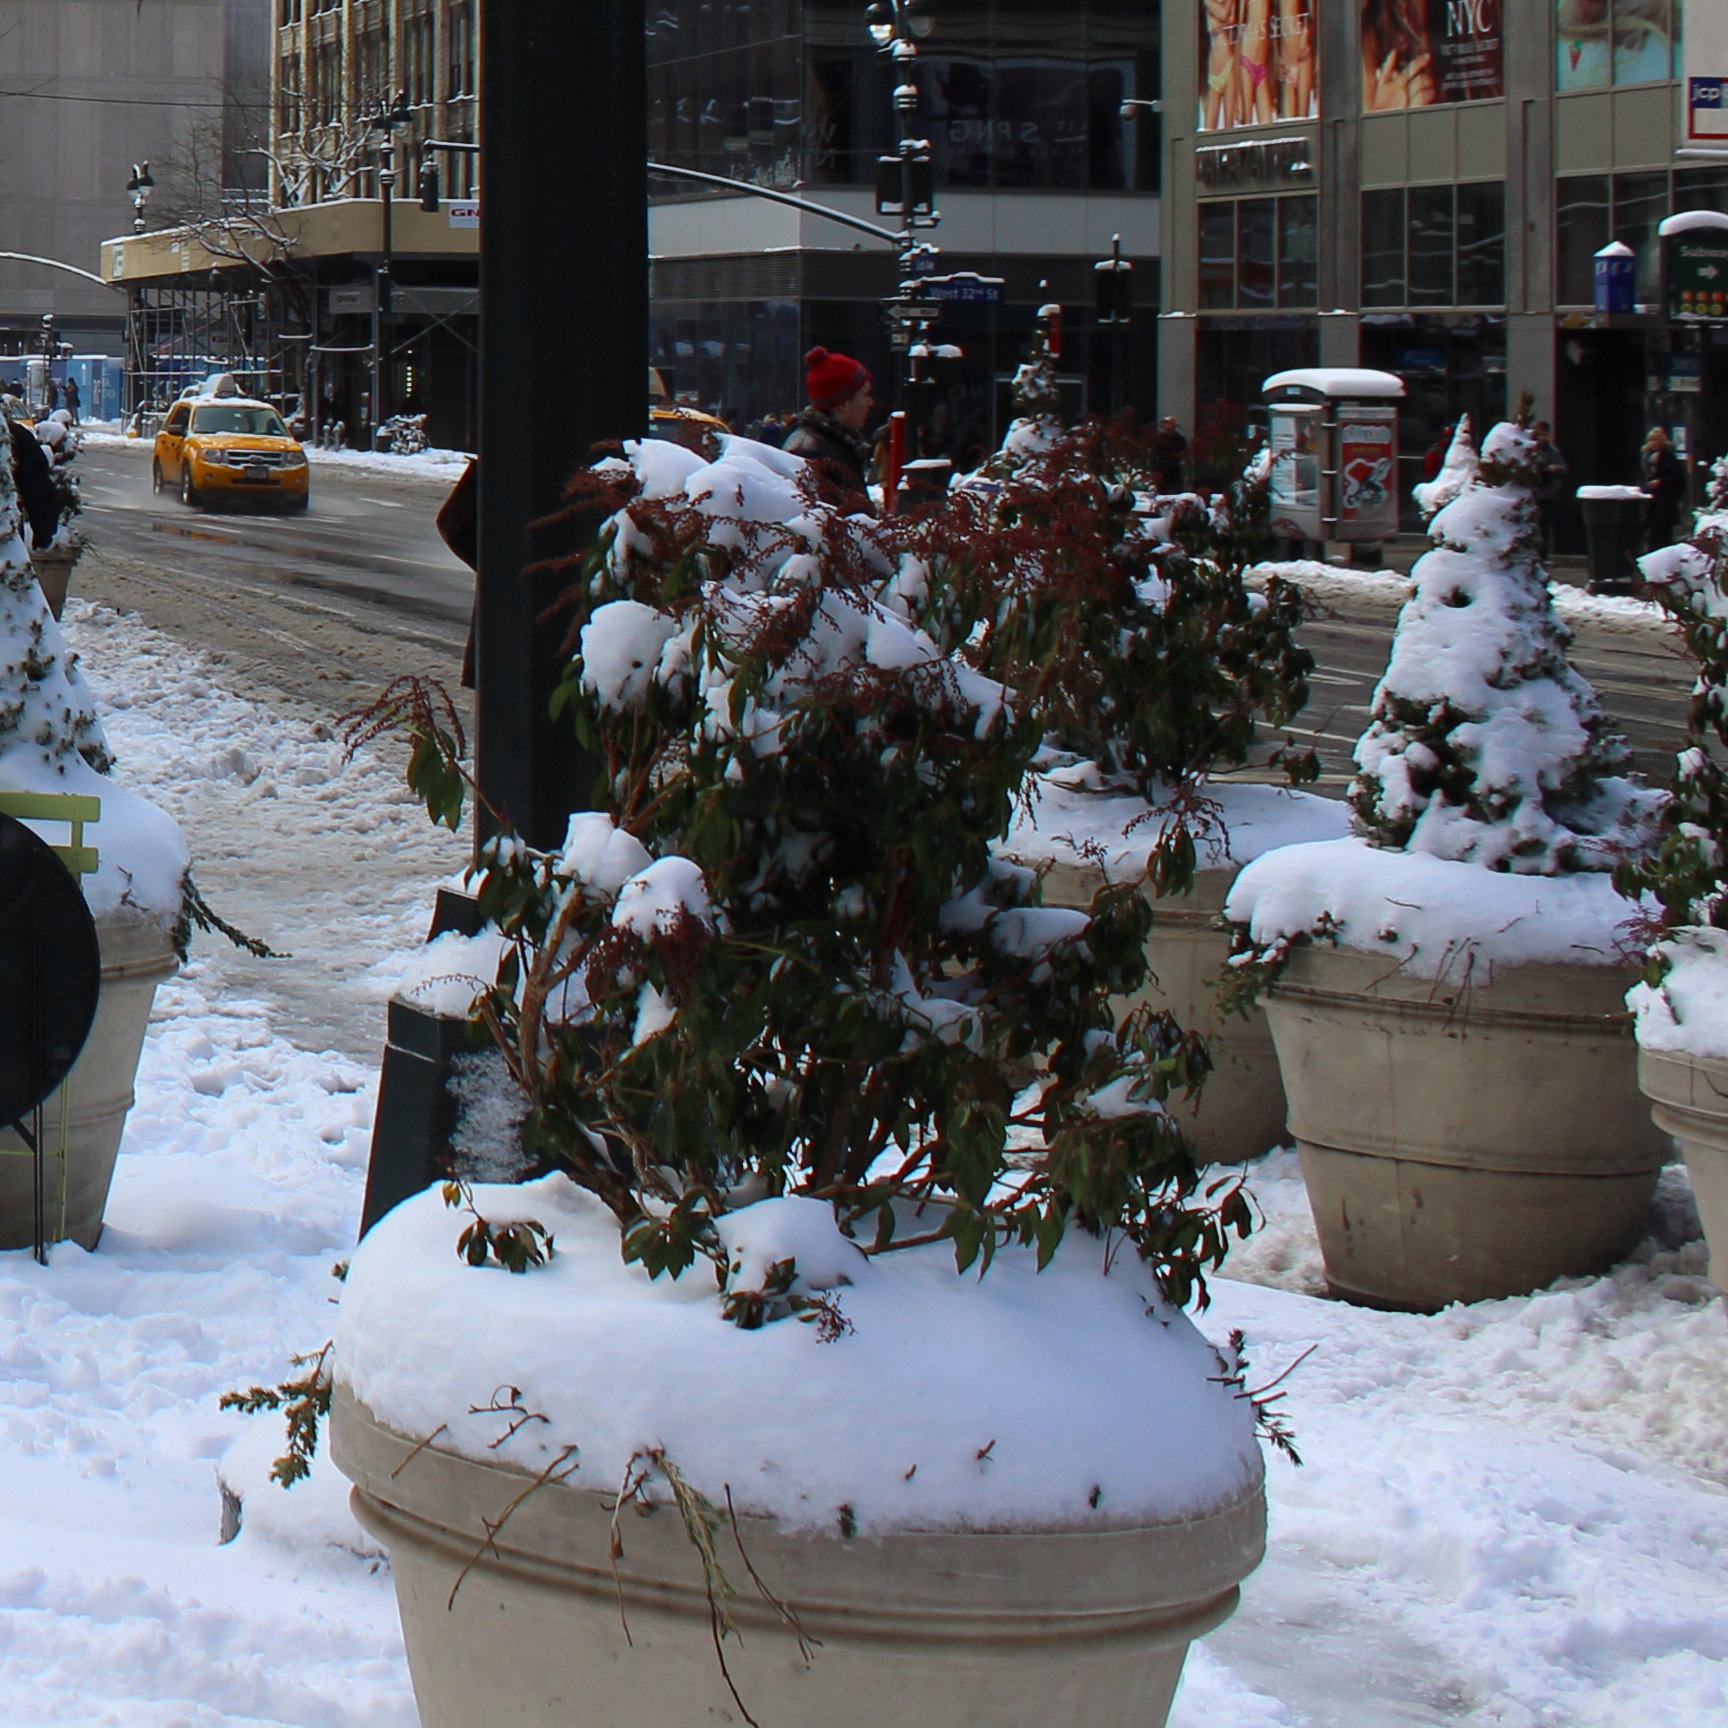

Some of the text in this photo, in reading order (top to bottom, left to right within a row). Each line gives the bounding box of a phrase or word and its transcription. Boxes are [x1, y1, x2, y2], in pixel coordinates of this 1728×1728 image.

[1691, 84, 1720, 102] jcp
[929, 287, 959, 300] West
[986, 288, 999, 301] St
